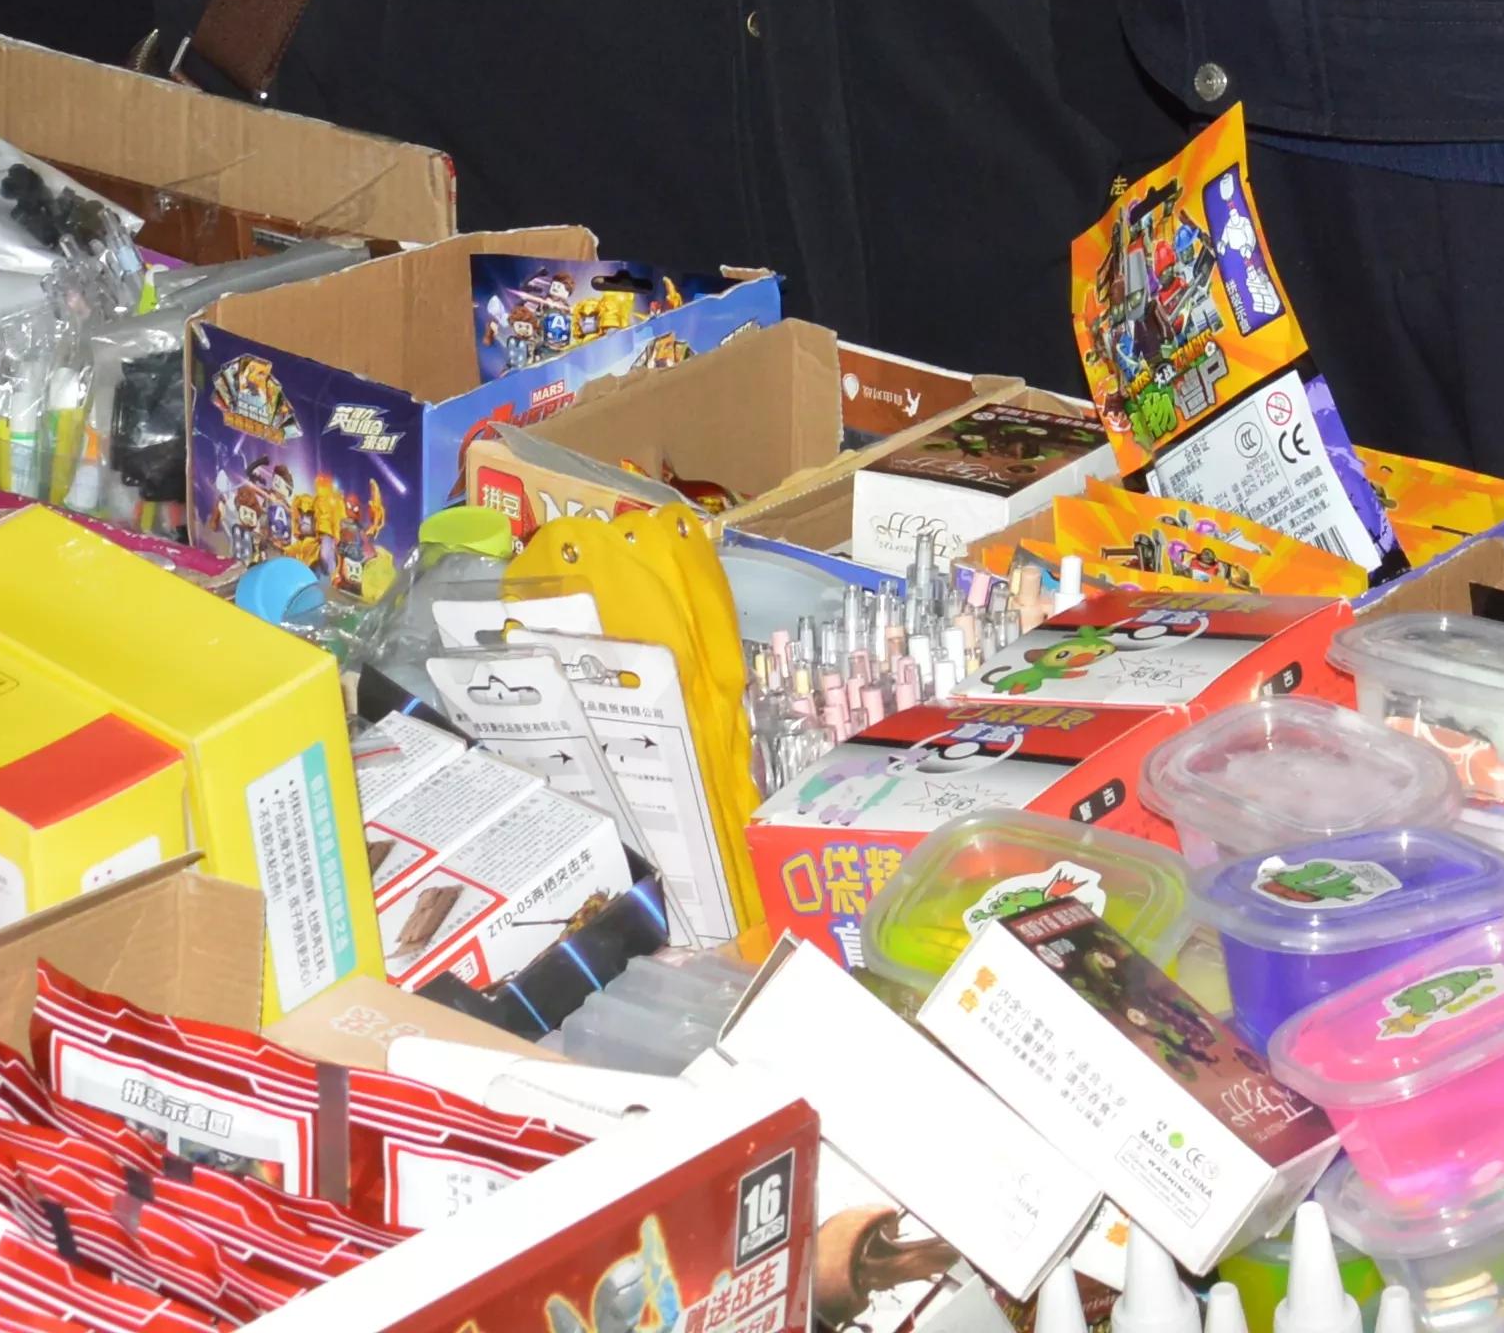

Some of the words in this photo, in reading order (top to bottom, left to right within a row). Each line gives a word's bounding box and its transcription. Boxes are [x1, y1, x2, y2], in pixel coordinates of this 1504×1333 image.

[532, 381, 565, 403] MARS
[481, 485, 520, 521] 拼豆
[487, 849, 593, 940] ZTD-05两栖突击车
[959, 966, 997, 1013] 警告
[121, 1079, 234, 1139] 拼装示意图
[1139, 1128, 1173, 1159] MADE
[1180, 1162, 1217, 1200] CHINA
[744, 1174, 783, 1233] 16
